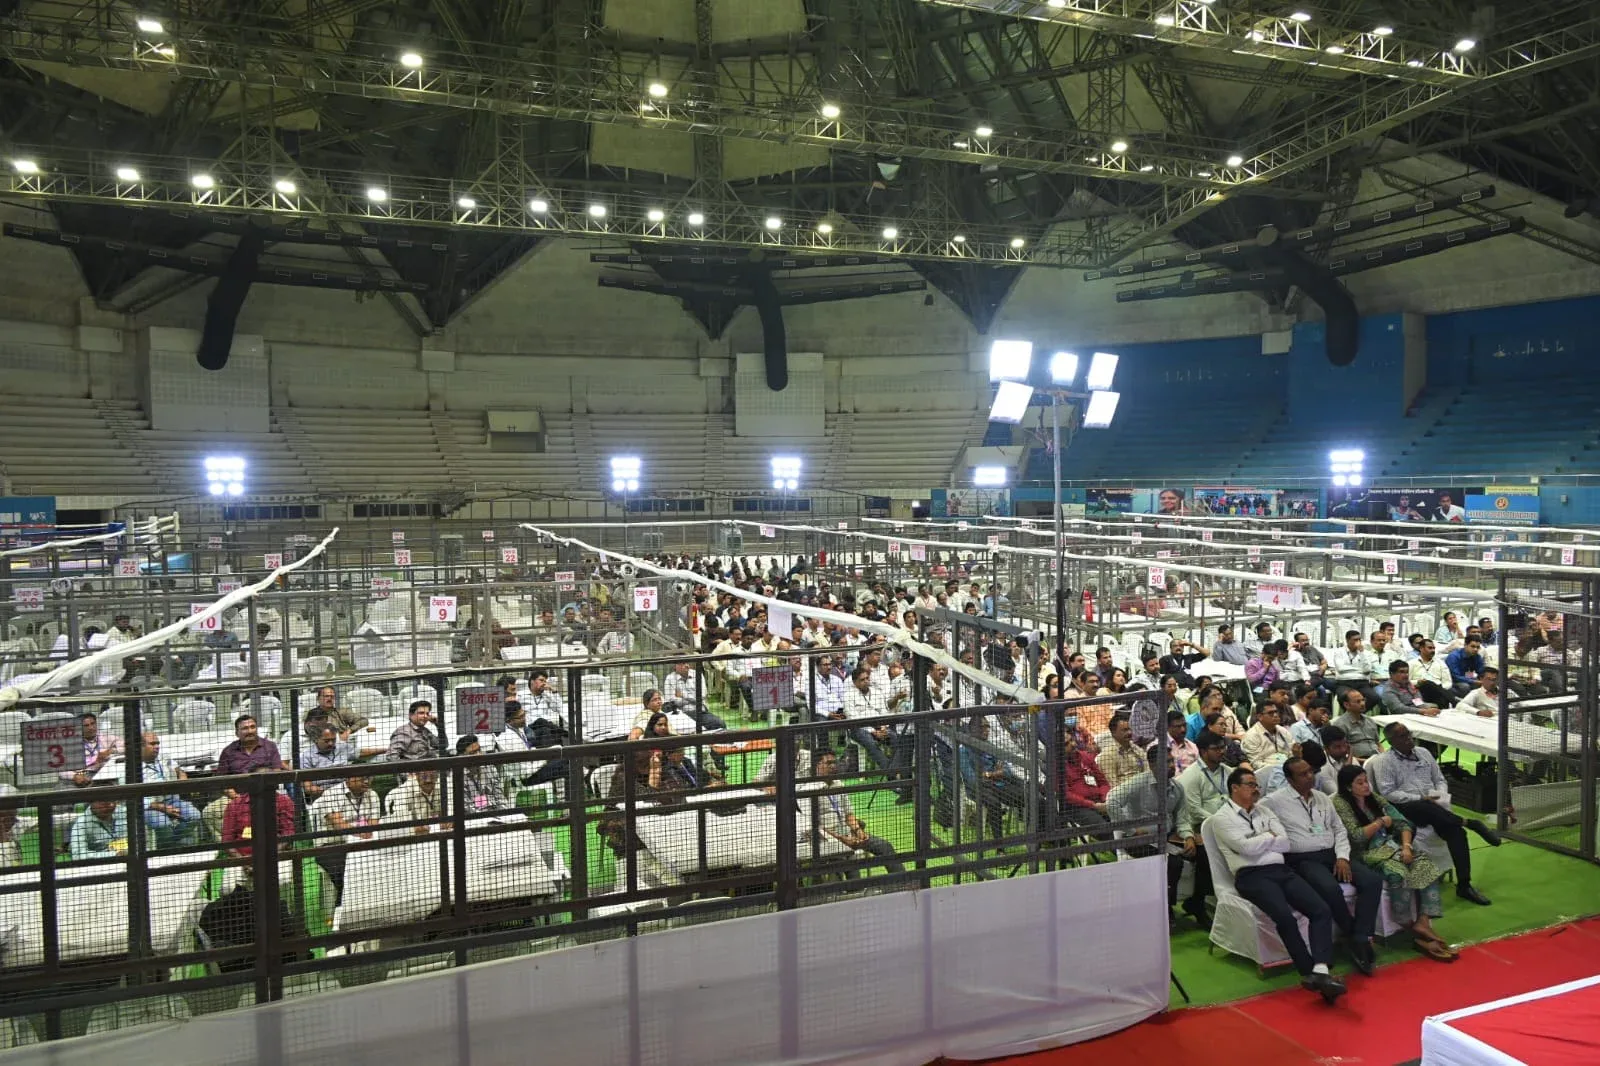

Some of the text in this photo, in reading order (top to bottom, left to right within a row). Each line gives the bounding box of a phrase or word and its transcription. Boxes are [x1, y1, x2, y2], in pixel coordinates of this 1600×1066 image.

[268, 560, 279, 569] 24
[398, 557, 408, 565] 23
[122, 566, 136, 574] 25
[1152, 575, 1162, 584] 50
[643, 598, 650, 609] 8
[1272, 594, 1280, 606] 4
[438, 608, 448, 620] 9
[460, 690, 486, 706] टेबल
[768, 686, 778, 706] 1
[474, 709, 490, 731] 2
[26, 724, 61, 741] टेबल
[47, 744, 65, 768] 3
